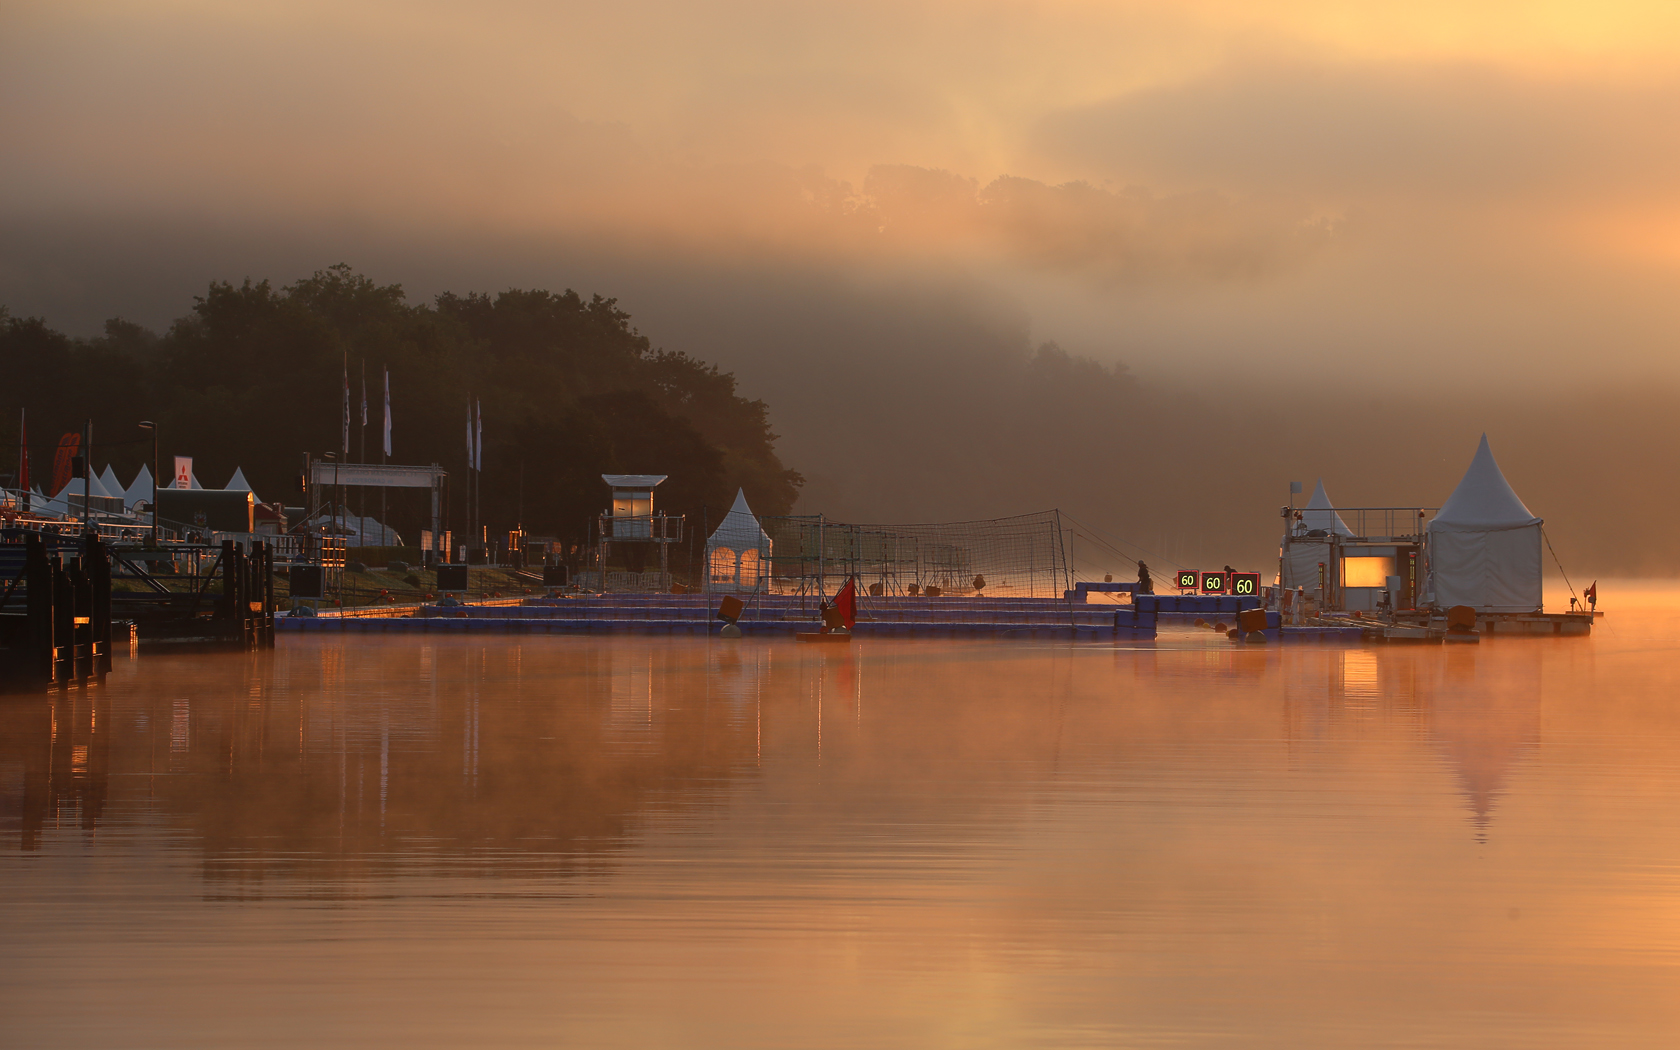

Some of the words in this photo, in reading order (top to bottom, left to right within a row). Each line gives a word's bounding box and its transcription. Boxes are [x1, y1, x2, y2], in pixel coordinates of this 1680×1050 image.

[1181, 575, 1194, 586] 60
[1206, 577, 1221, 589] 60
[1236, 579, 1253, 594] 60
